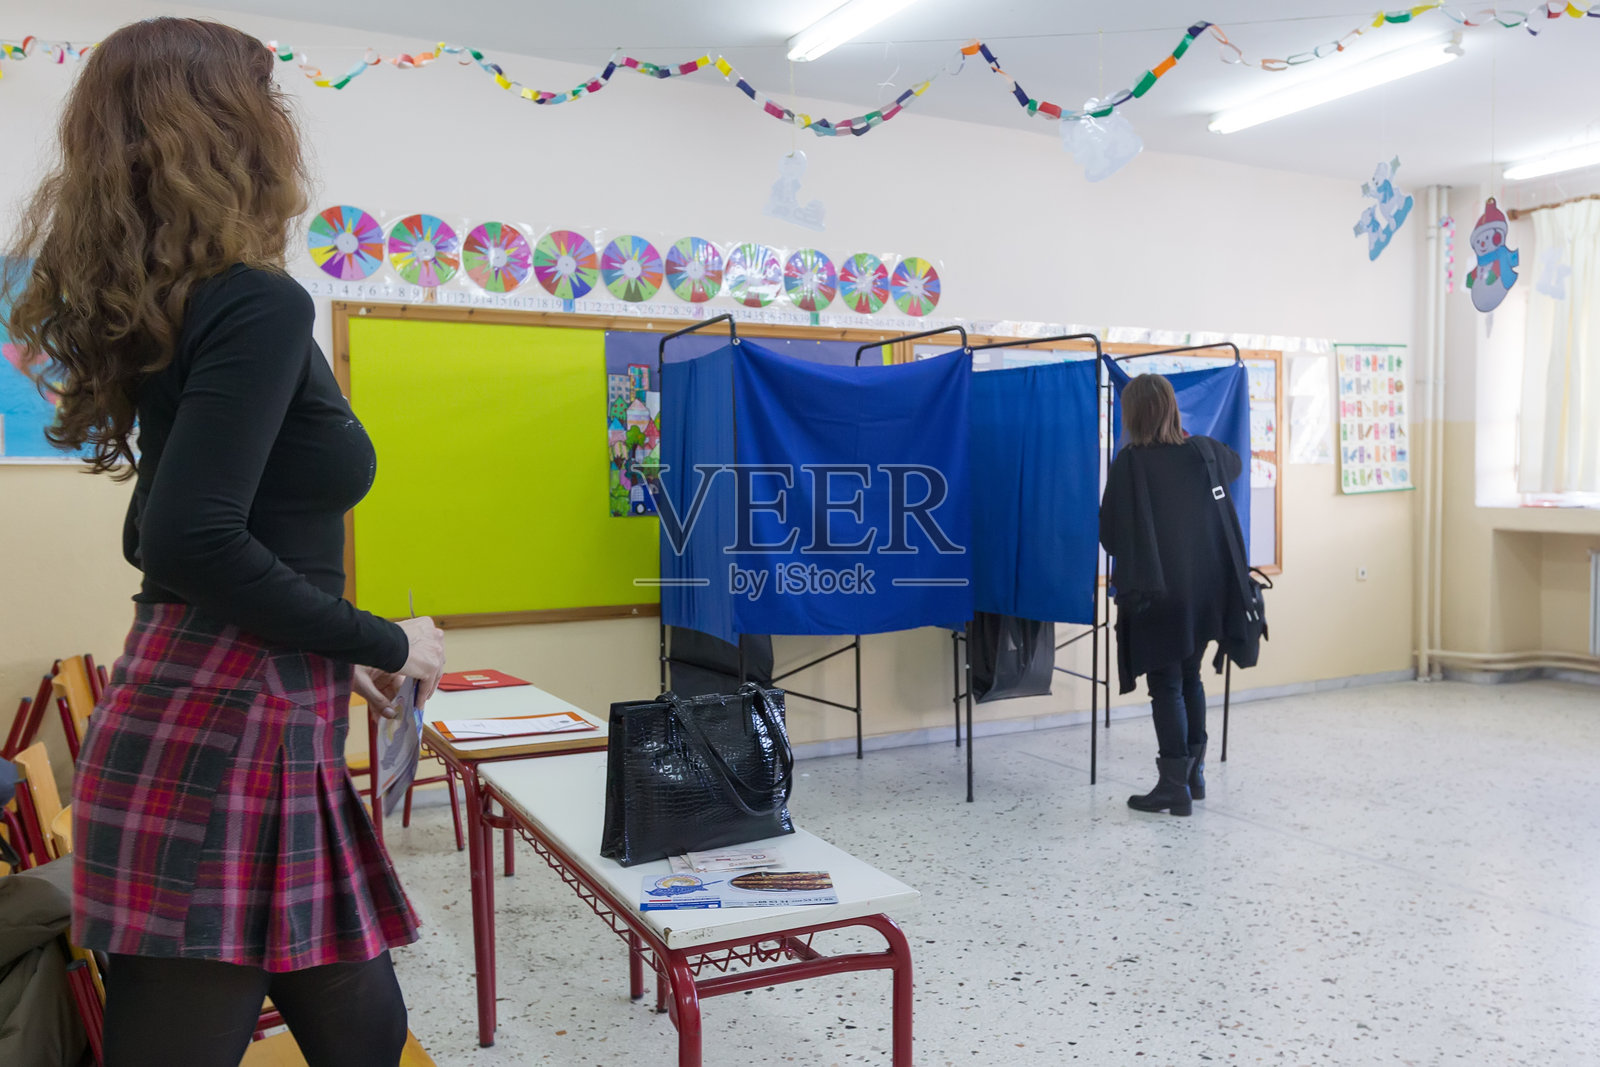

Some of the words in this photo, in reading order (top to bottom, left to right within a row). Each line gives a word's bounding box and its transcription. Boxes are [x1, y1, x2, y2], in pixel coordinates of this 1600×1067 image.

[311, 283, 319, 293] 2
[327, 284, 333, 294] 3
[342, 285, 349, 295] 4
[369, 286, 376, 296] 6
